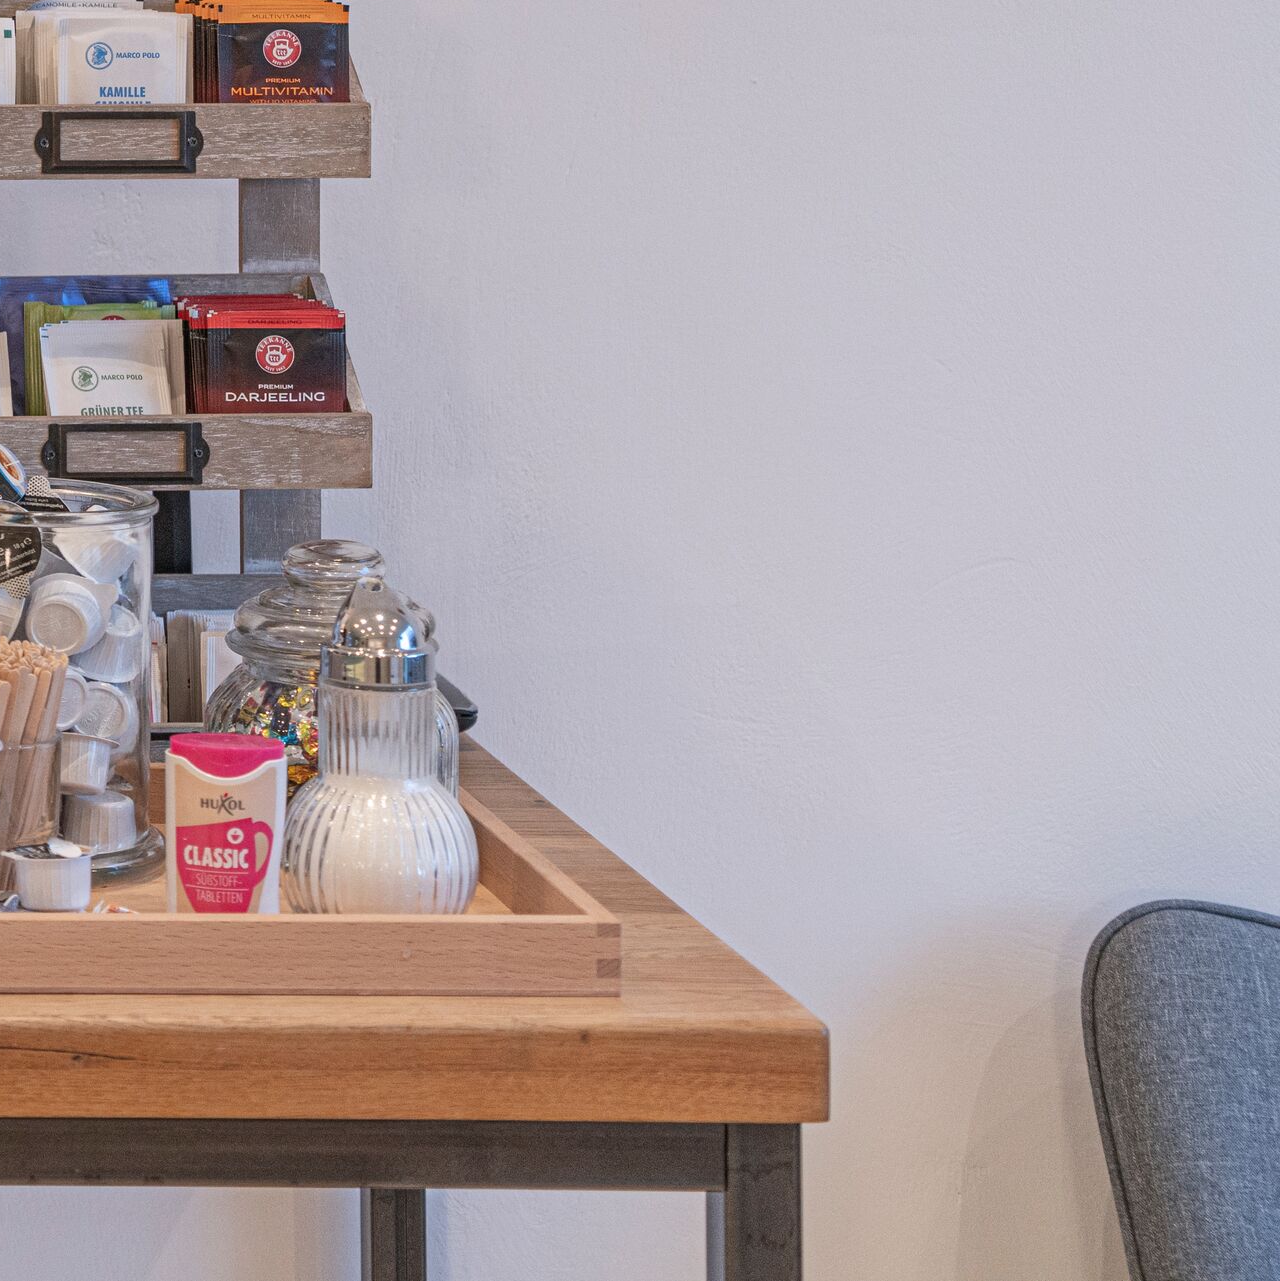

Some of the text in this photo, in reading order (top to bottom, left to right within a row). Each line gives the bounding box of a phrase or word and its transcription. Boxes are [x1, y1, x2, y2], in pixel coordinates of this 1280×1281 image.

[99, 86, 146, 98] KAMILLE
[231, 87, 334, 96] MULTIVITAMIN
[258, 337, 293, 352] TEEKANNE
[225, 392, 326, 402] DARJEELING
[81, 405, 144, 416] GRÜNER TEE
[200, 793, 245, 816] HUXOL
[183, 844, 249, 869] CLASSIC
[195, 889, 244, 904] TABLETTEN
